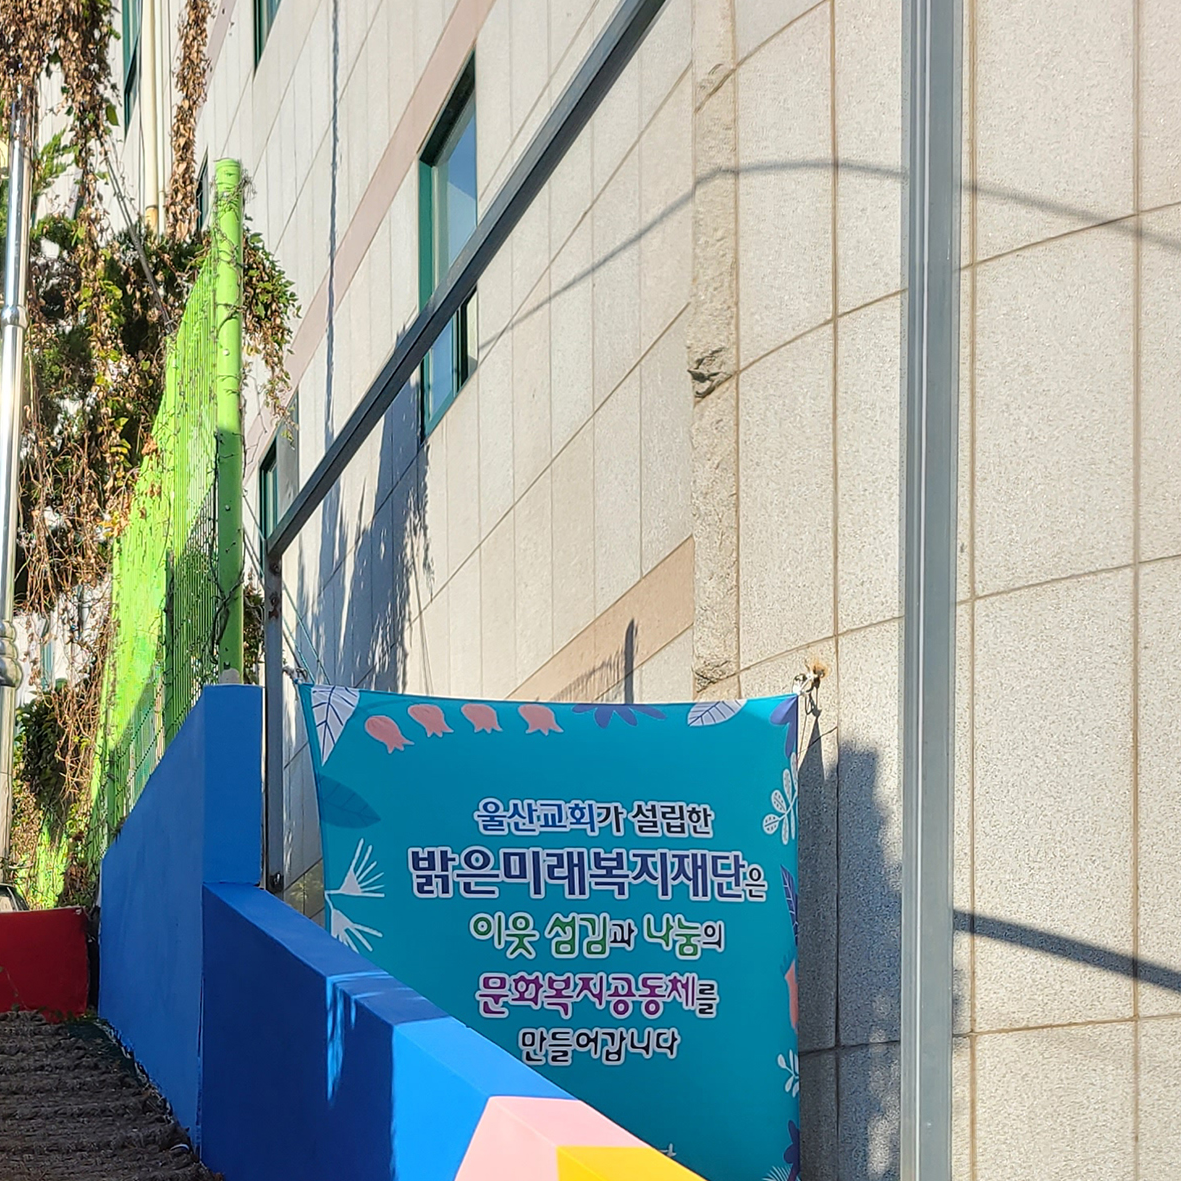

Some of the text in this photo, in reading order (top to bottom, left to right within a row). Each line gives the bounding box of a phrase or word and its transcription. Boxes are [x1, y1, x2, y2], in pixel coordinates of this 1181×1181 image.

[475, 799, 713, 837] 울산교회가 설립한
[409, 847, 768, 900] 밝은미래복지재단은
[471, 913, 724, 958] 이웃 섬김과 나눔의
[476, 973, 718, 1017] 문화복지공동체를
[519, 1028, 679, 1064] 만들어갑니다
